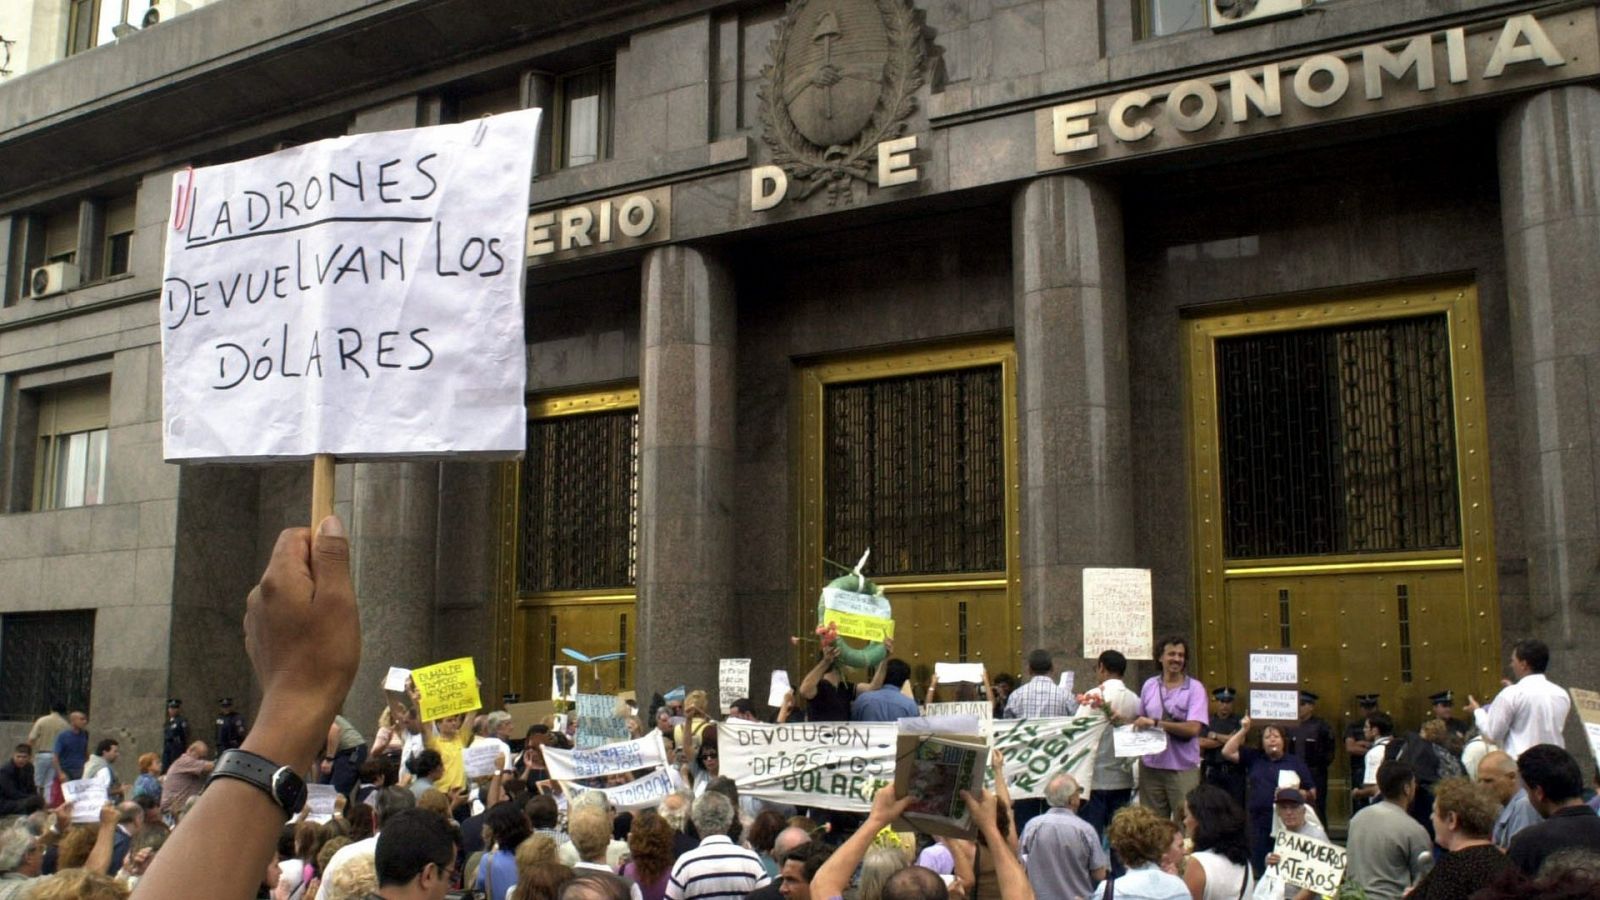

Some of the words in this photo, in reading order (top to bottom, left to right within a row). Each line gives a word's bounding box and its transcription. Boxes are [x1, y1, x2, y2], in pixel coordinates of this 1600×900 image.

[1052, 14, 1566, 154] ECONOMIA
[186, 153, 437, 243] LADRONES
[164, 237, 404, 329] DEVUELVAN
[436, 221, 505, 278] LOS
[1276, 831, 1348, 870] BANQUEROS
